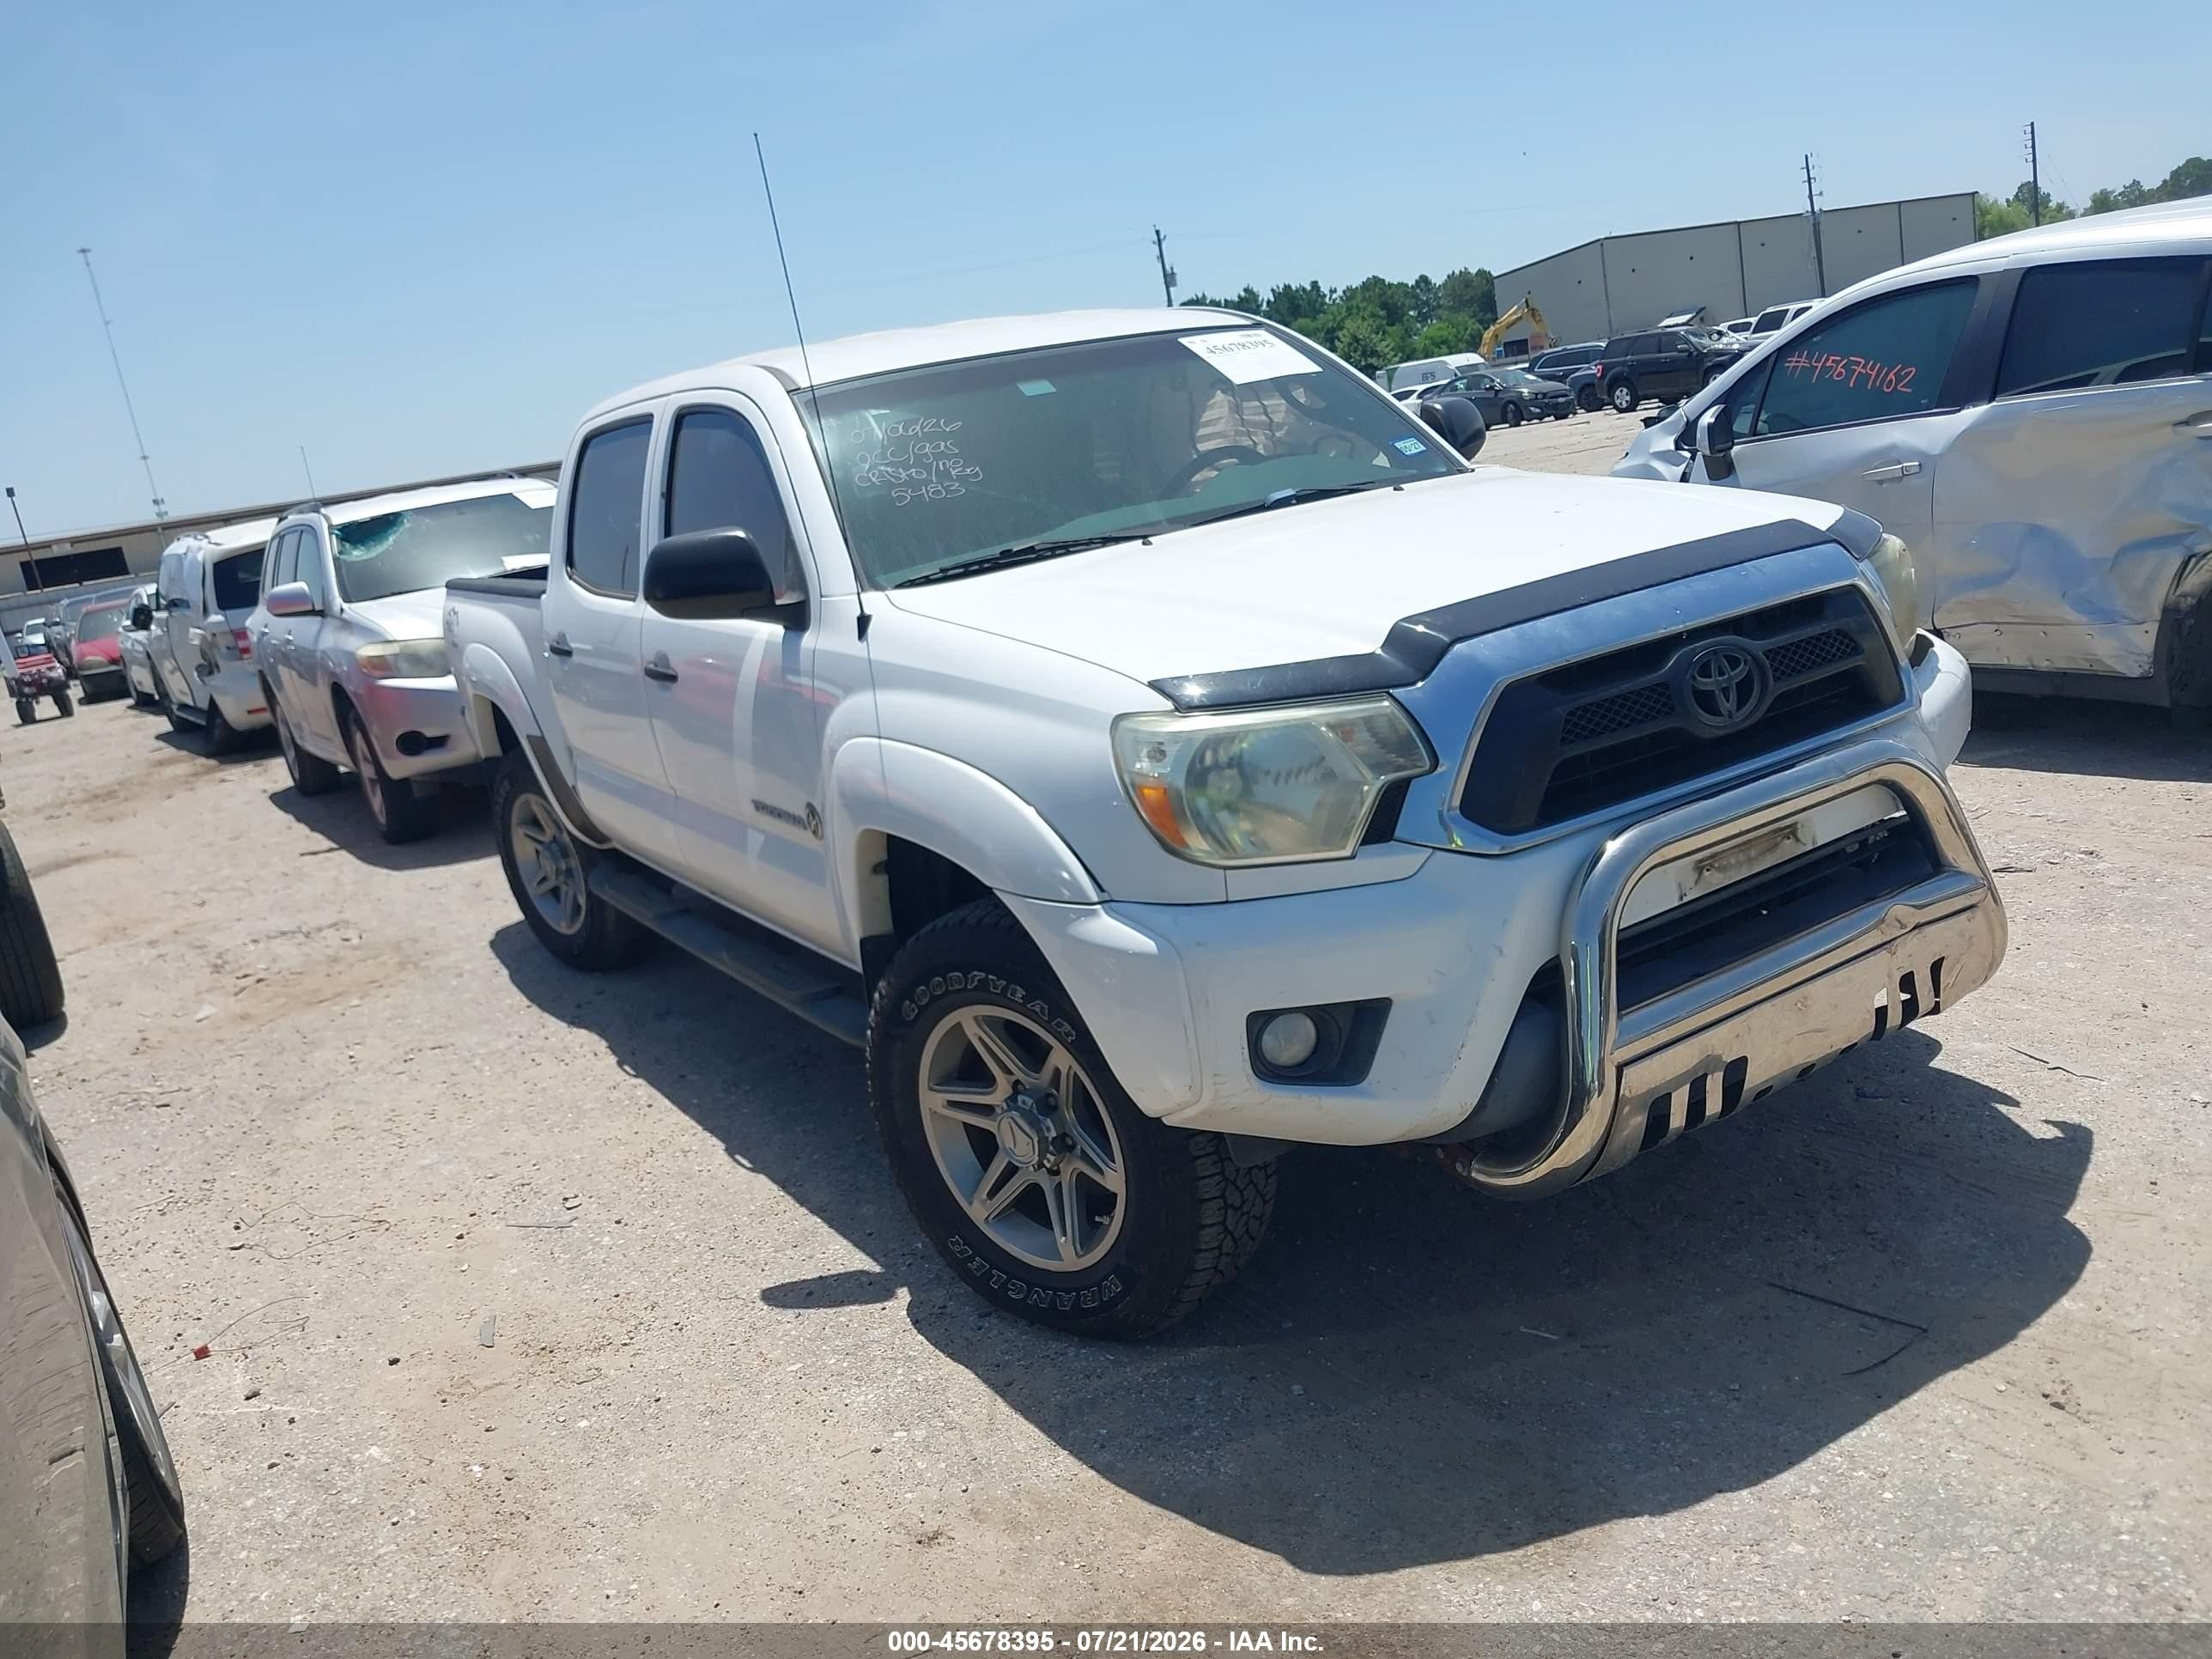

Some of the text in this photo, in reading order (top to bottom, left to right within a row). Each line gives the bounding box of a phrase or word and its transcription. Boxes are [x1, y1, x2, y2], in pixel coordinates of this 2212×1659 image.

[1206, 339, 1276, 355] 45678395
[1784, 350, 1917, 392] #45674162
[891, 482, 966, 506] 5483
[902, 971, 1076, 1043] GOODYEAR
[948, 1235, 1122, 1310] WRANGLER
